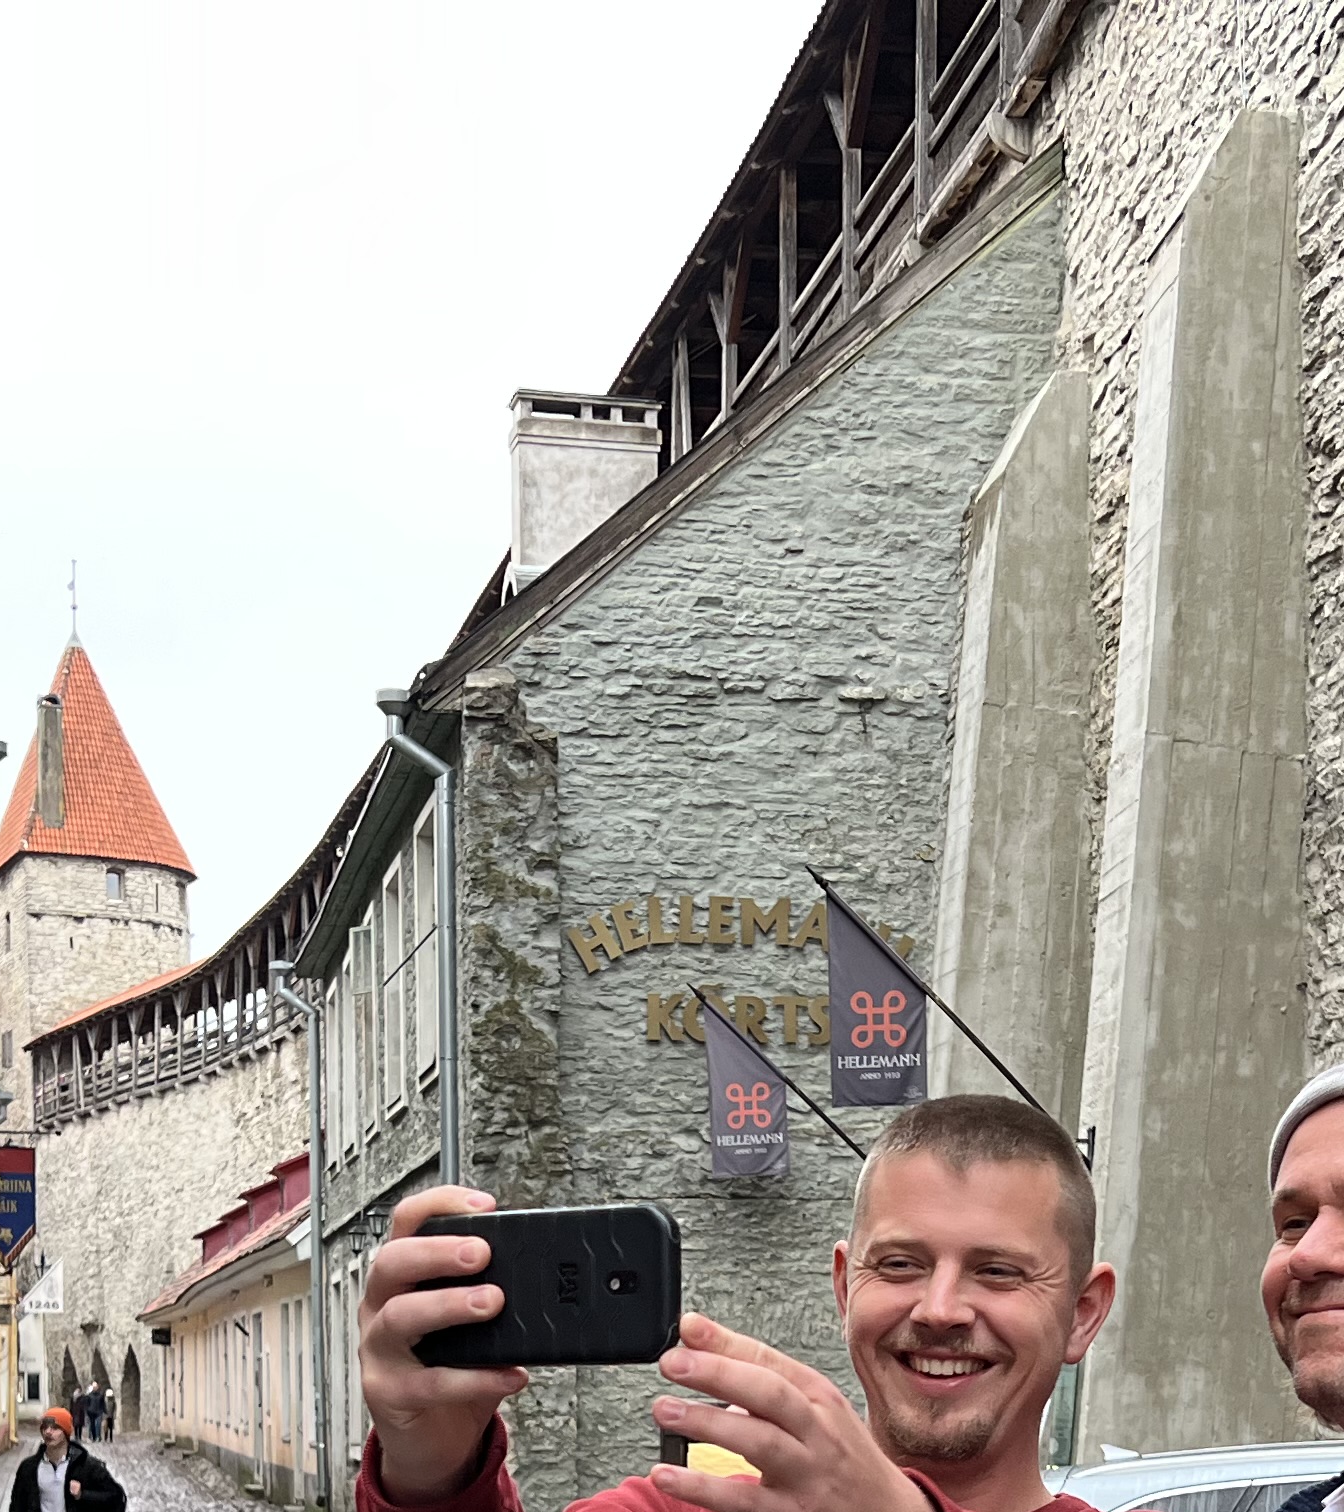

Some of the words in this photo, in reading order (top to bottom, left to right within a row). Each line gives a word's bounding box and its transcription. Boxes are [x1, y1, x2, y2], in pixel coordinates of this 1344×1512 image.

[566, 894, 916, 975] HELLEMA
[837, 1052, 921, 1070] HELLEMANN
[716, 1131, 785, 1147] HELLEMANN
